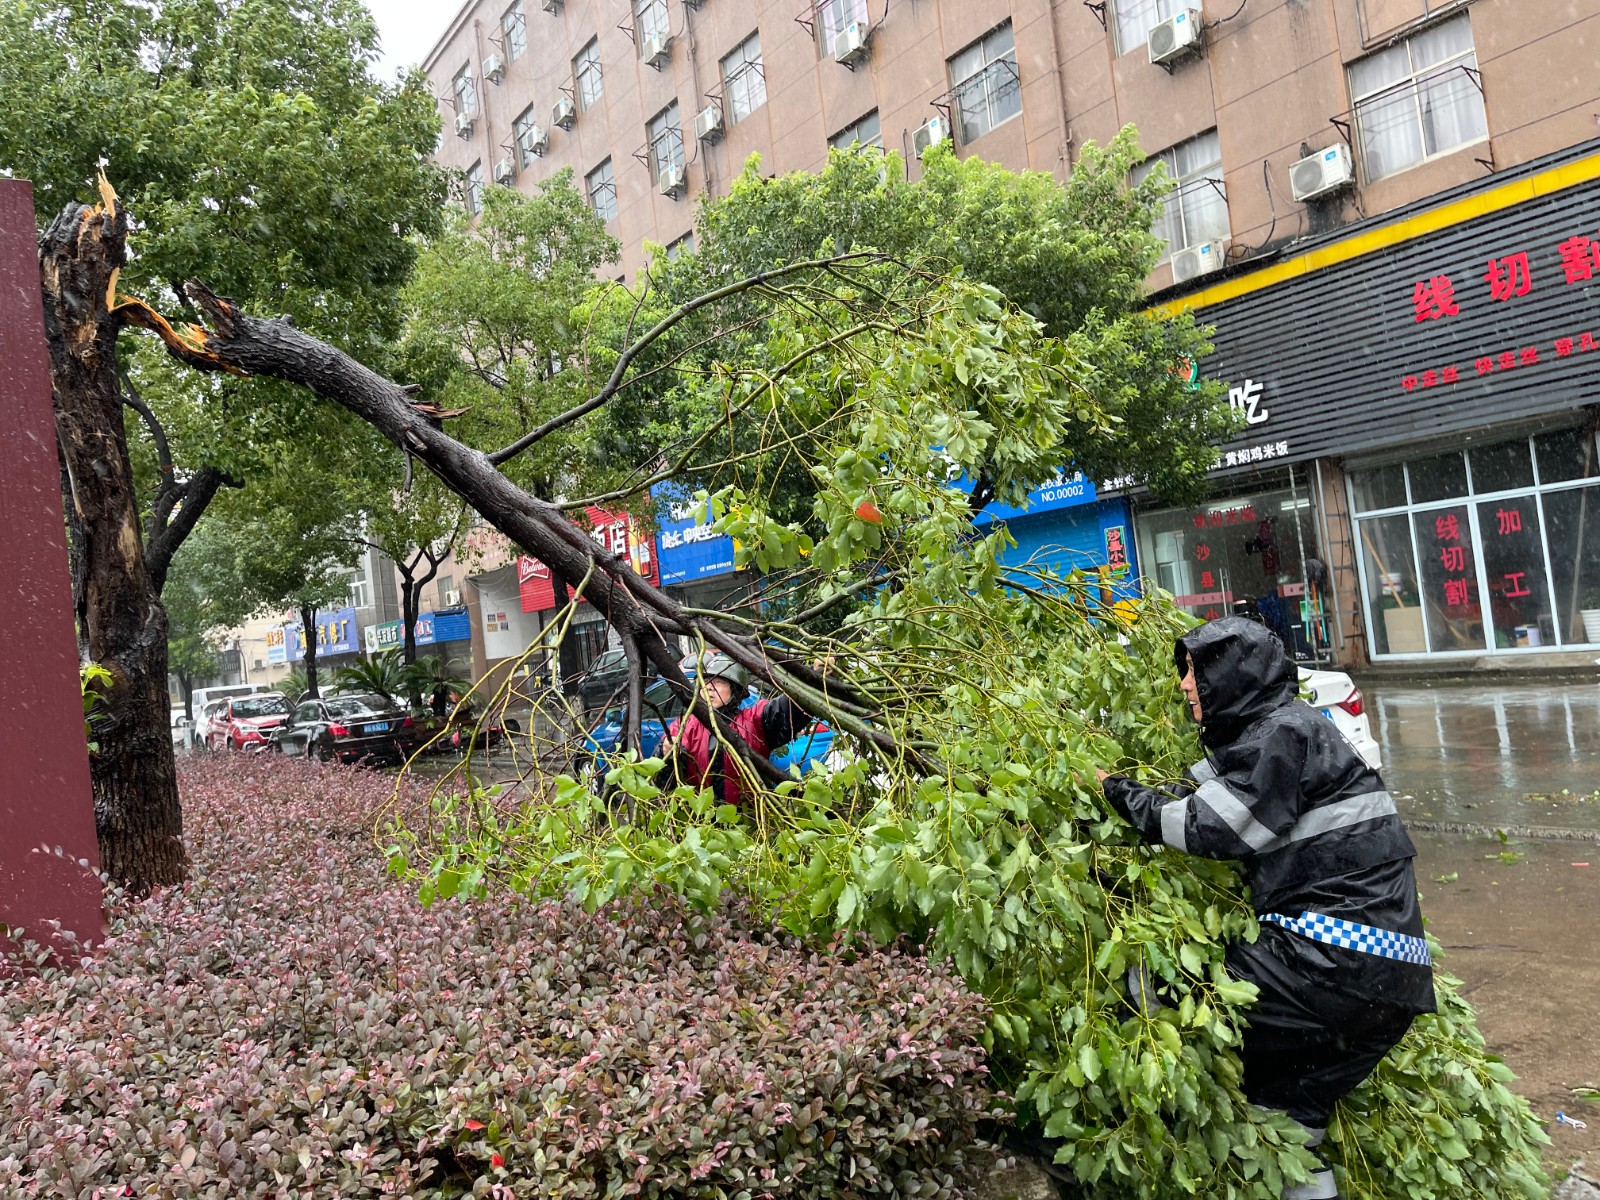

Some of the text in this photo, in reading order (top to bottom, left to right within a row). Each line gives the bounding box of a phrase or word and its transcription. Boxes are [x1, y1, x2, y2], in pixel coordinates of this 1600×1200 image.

[1412, 229, 1600, 323] 线切割
[1402, 332, 1599, 391] 中走丝 快走丝 穿孔
[1225, 440, 1289, 467] 黄焖鸡米饭
[1041, 484, 1084, 503] NO.00002
[1193, 505, 1257, 528] 欢迎光临
[1435, 513, 1470, 606] 线切割
